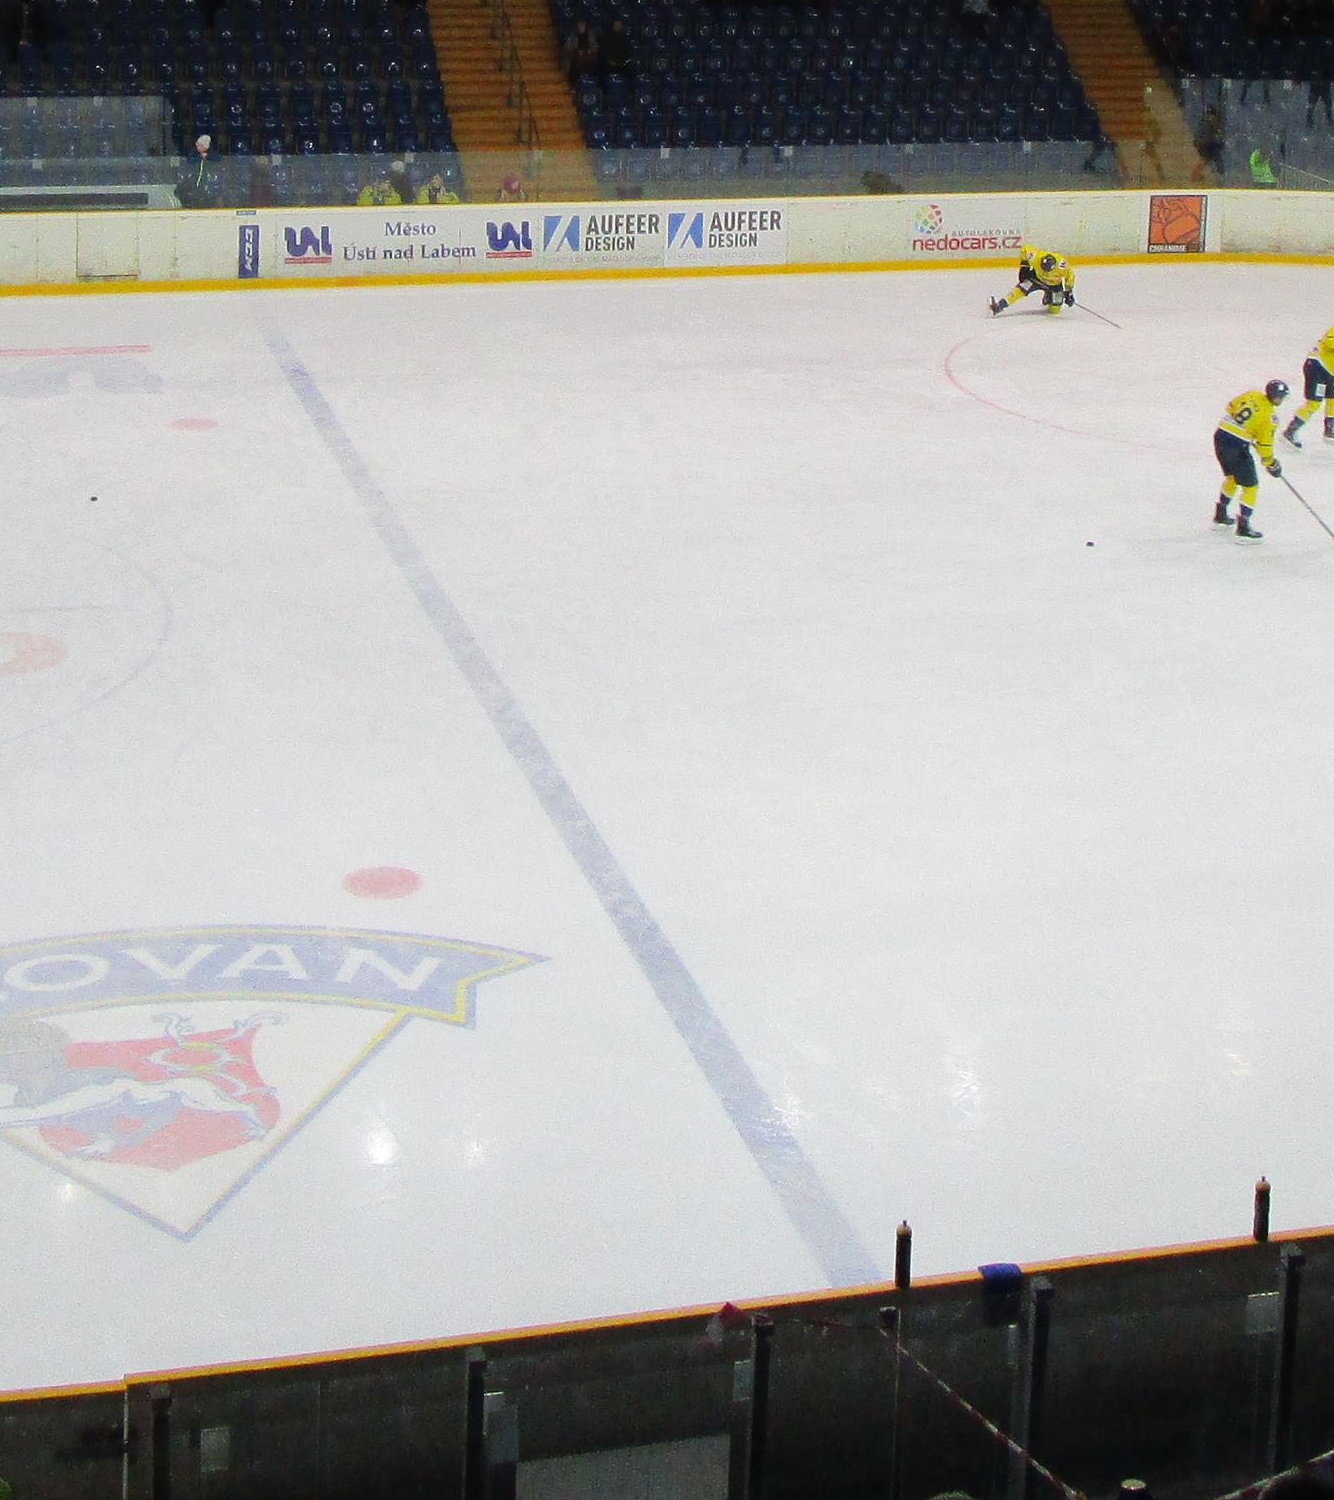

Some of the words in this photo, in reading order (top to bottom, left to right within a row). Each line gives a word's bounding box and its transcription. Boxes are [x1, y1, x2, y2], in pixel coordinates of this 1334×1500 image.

[384, 222, 436, 237] Město
[586, 213, 660, 235] AUFEER
[709, 210, 782, 231] AUFEER
[585, 236, 636, 252] DESIGN
[708, 233, 758, 248] DESIGN
[912, 233, 1022, 252] nedocars.cz
[343, 243, 376, 261] Ústí
[382, 244, 415, 260] nad
[421, 243, 476, 259] Labem
